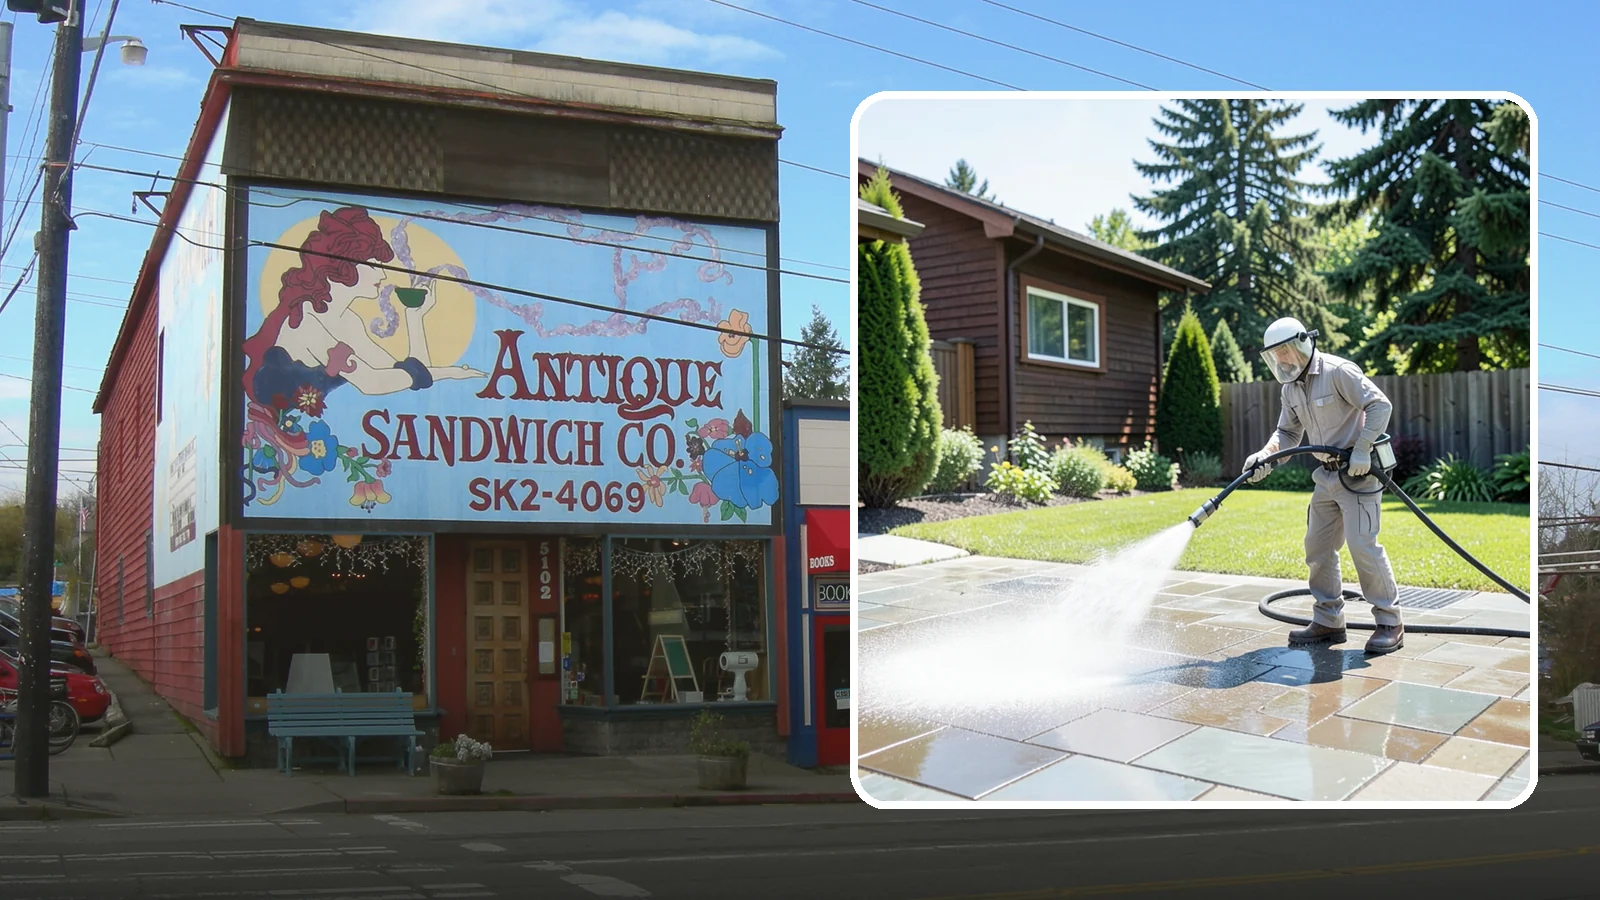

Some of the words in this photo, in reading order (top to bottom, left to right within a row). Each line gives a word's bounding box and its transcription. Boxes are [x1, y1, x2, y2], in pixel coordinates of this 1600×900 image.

[475, 329, 723, 421] ANTIQUE
[361, 408, 604, 467] SANDWICH
[617, 422, 685, 469] CO.
[467, 477, 646, 513] SK2-4069
[540, 541, 552, 600] 5102
[809, 554, 835, 569] BOOKS
